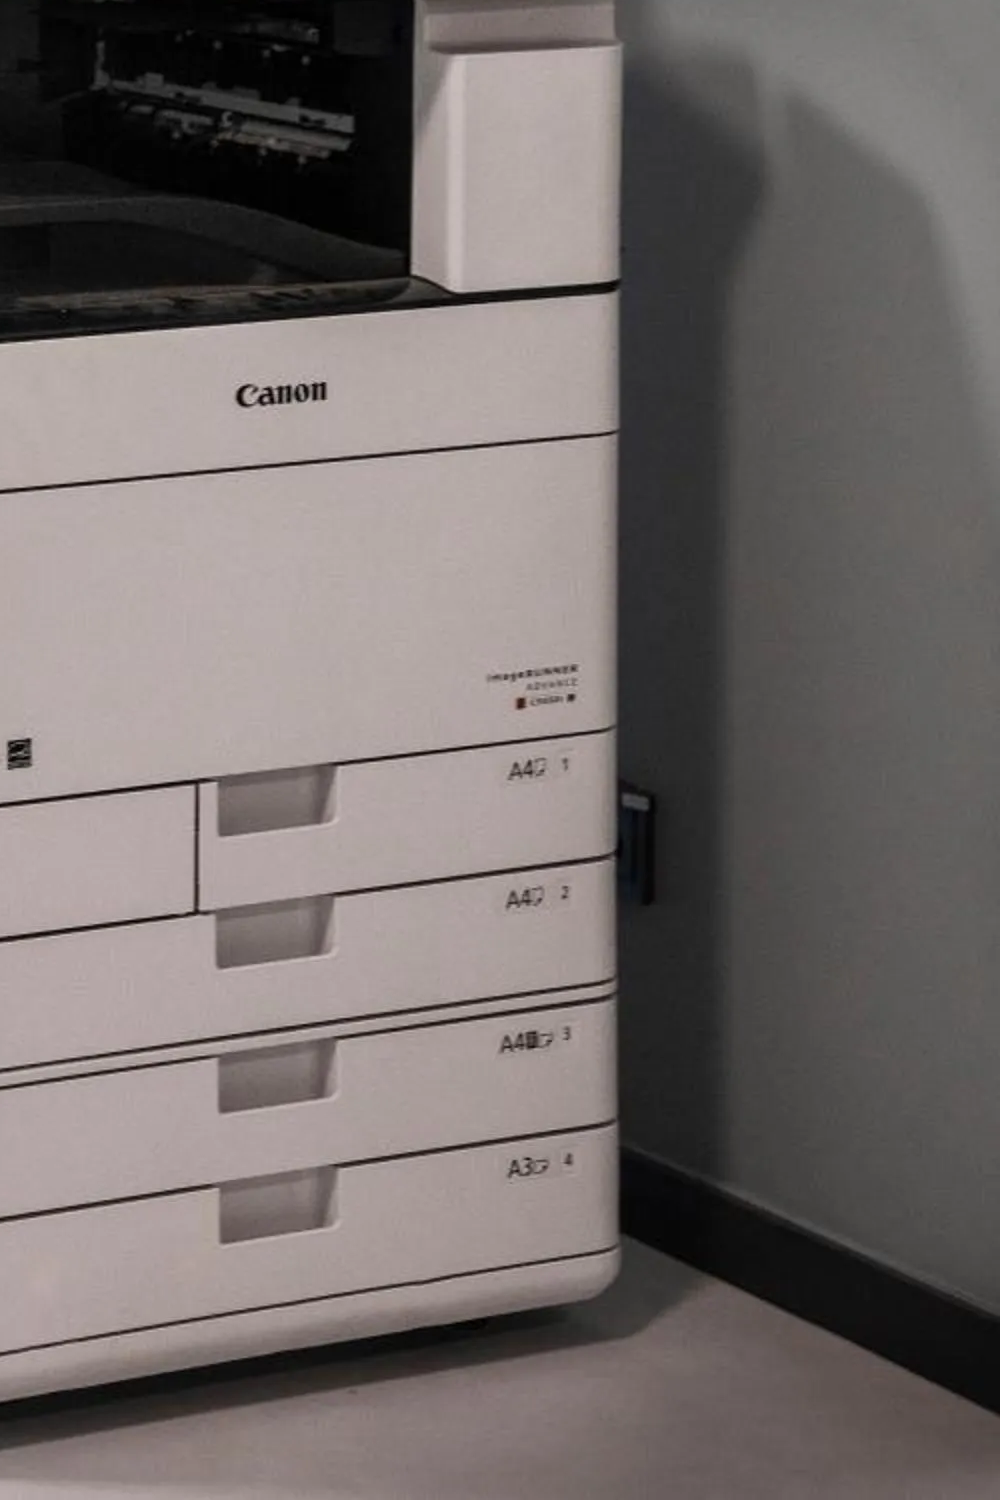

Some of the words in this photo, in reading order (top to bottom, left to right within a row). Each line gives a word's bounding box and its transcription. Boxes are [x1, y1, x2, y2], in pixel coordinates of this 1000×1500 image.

[235, 381, 328, 408] Canon
[507, 759, 534, 781] A4
[505, 888, 531, 911] A4
[499, 1032, 525, 1054] A4
[507, 1156, 534, 1179] A3
